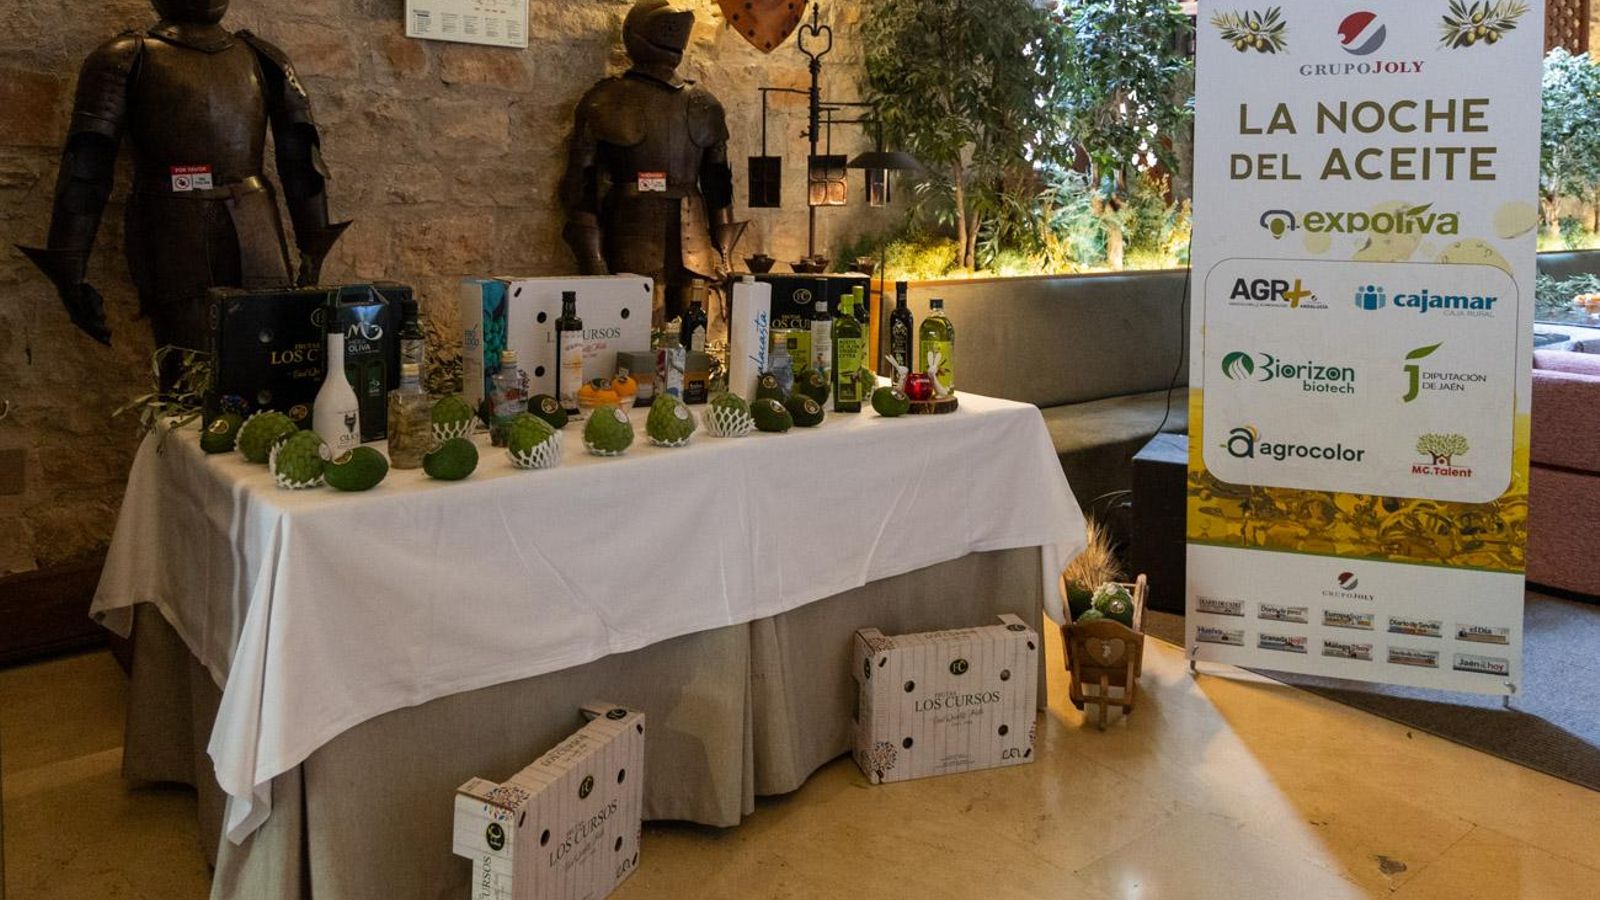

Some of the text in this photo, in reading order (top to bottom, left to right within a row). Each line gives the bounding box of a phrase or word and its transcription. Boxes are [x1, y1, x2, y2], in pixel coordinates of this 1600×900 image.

[1240, 98, 1490, 135] LA NOCHE
[1229, 147, 1497, 180] DEL ACEITE
[1303, 206, 1458, 235] expoliva
[1393, 289, 1497, 313] cajamar
[582, 328, 621, 340] URSOS
[271, 350, 303, 365] LOS
[1258, 352, 1355, 382] Biorizon
[1303, 380, 1355, 394] biotech
[1422, 371, 1487, 383] DIPUTACIÓN
[1422, 381, 1465, 392] DE JAÉN
[1260, 441, 1365, 463] agrocolor
[1487, 661, 1505, 671] hoy
[915, 690, 1001, 713] LOS CURSOS
[549, 842, 572, 868] LOS
[574, 799, 618, 843] CURSOS
